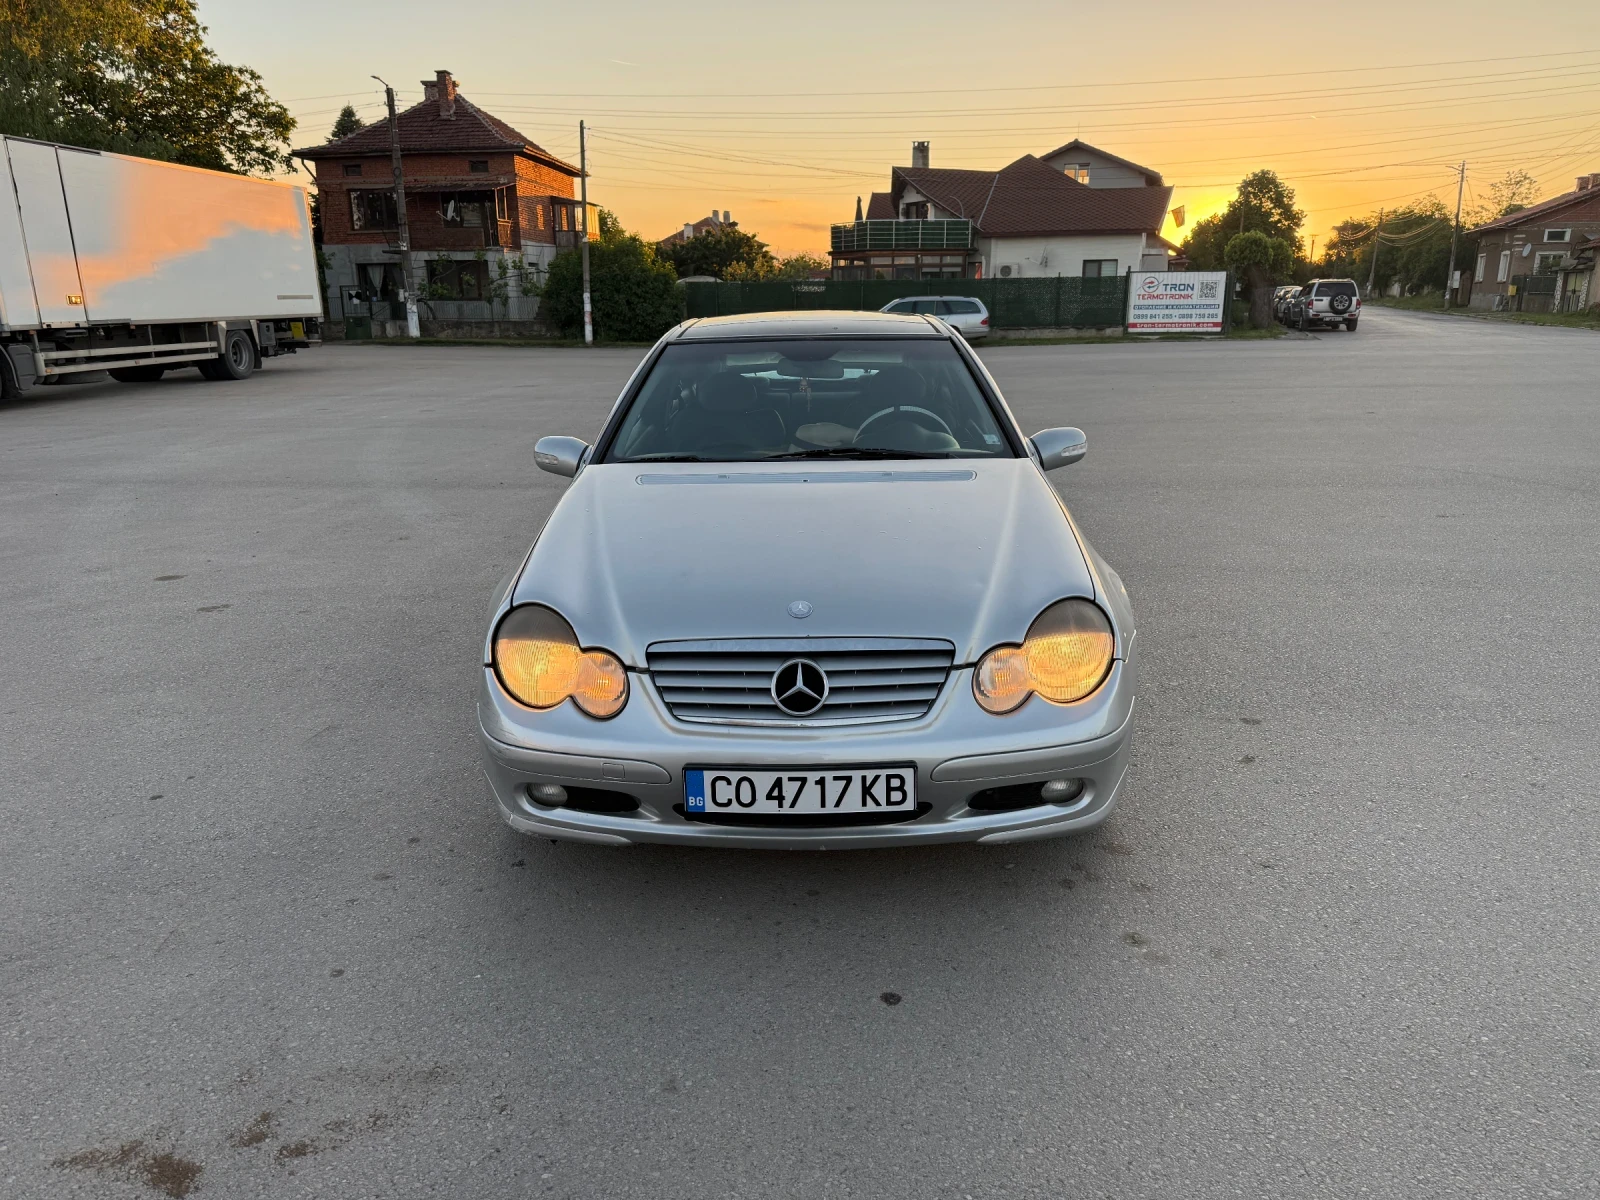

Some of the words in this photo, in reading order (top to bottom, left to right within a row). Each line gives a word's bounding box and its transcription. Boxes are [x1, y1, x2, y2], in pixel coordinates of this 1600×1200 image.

[1163, 283, 1194, 291] TRON
[710, 776, 757, 808] CO
[765, 776, 853, 809] 4717
[860, 773, 908, 808] KB
[688, 796, 704, 806] BG
